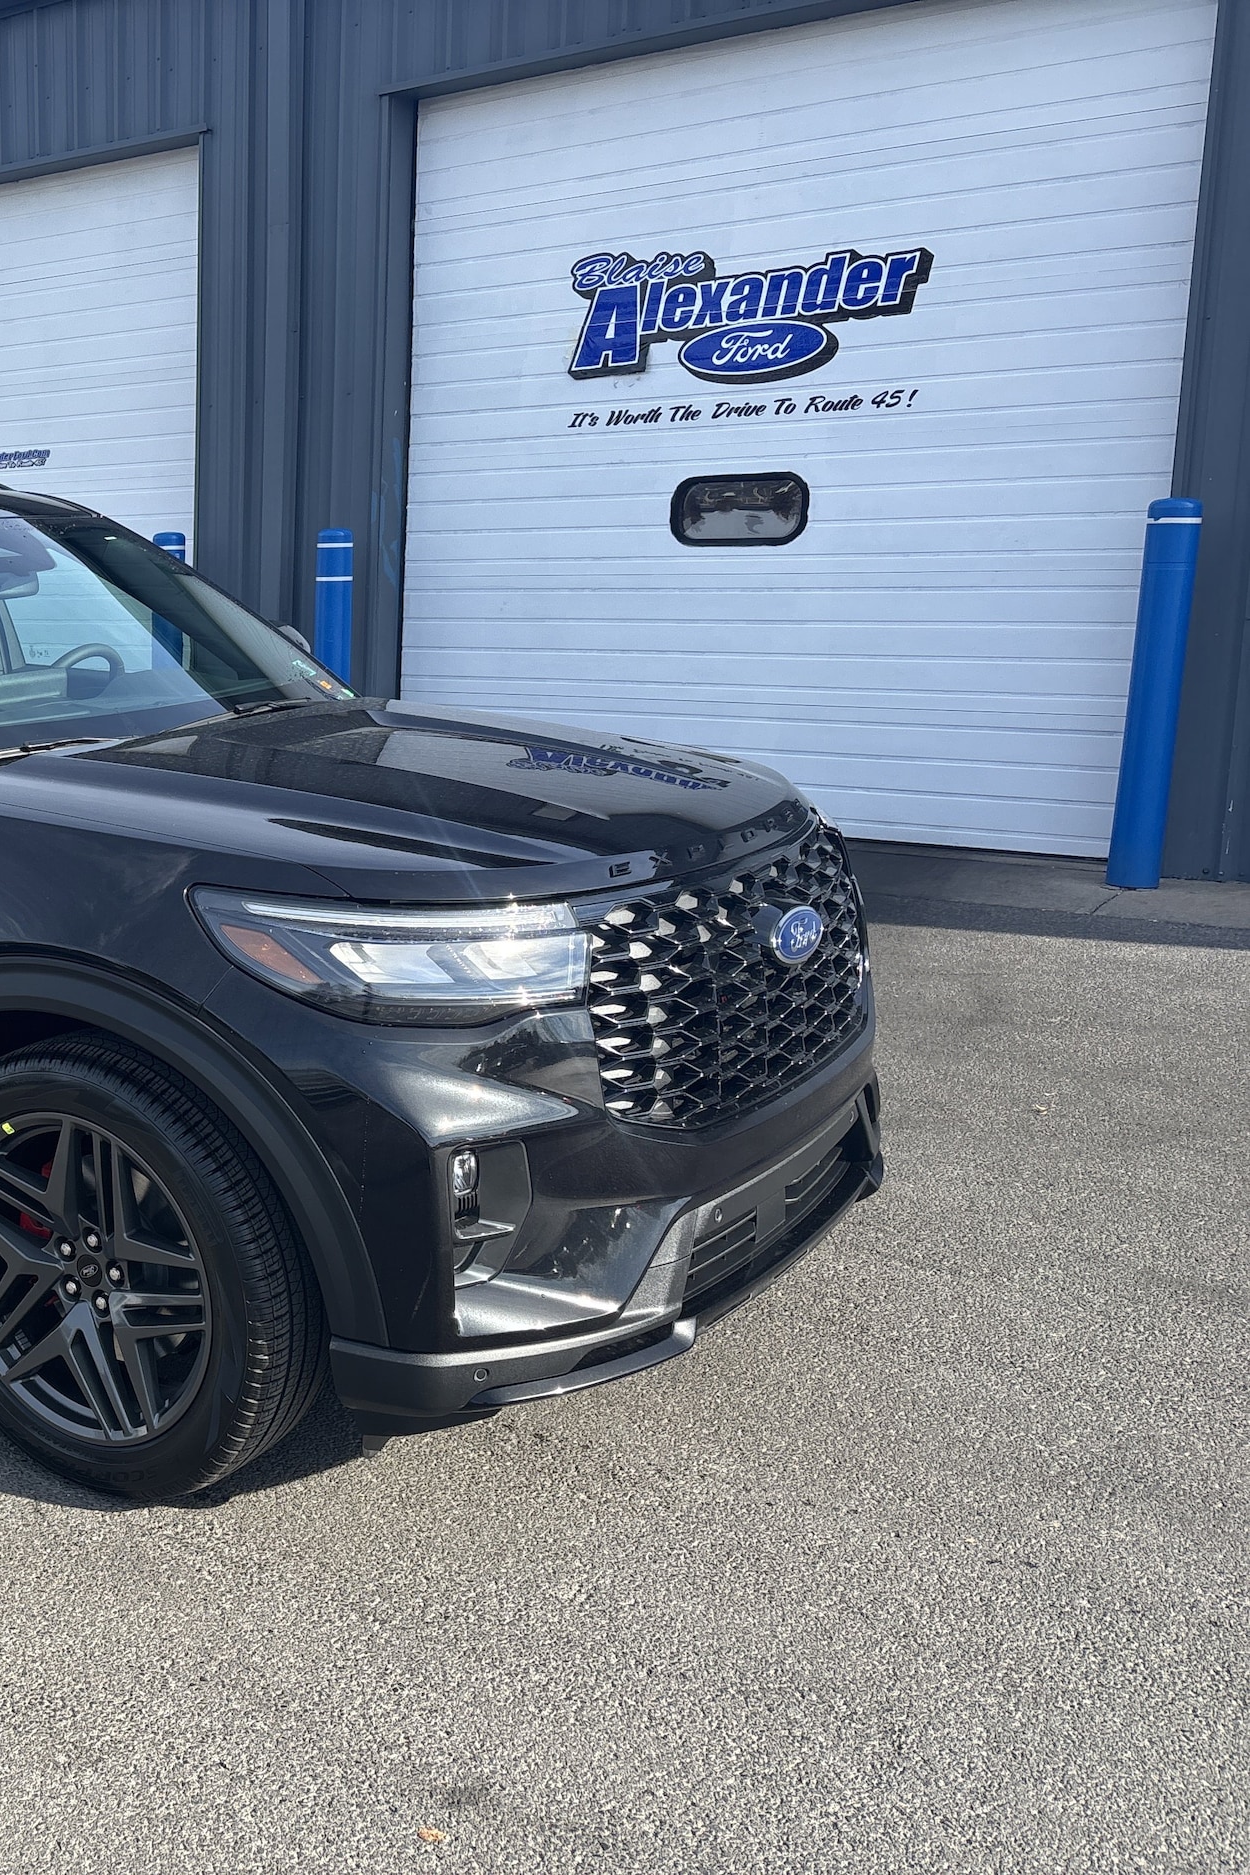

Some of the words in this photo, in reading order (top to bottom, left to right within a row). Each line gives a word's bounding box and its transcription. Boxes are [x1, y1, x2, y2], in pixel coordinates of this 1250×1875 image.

[573, 251, 705, 290] Blaise
[570, 250, 924, 373] Alexander
[711, 329, 791, 365] Ford
[567, 411, 599, 428] It's
[605, 406, 663, 427] Worth
[669, 404, 703, 423] The
[711, 400, 766, 421] Drive
[773, 397, 798, 416] To
[804, 394, 864, 414] Route
[790, 917, 818, 953] Ford
